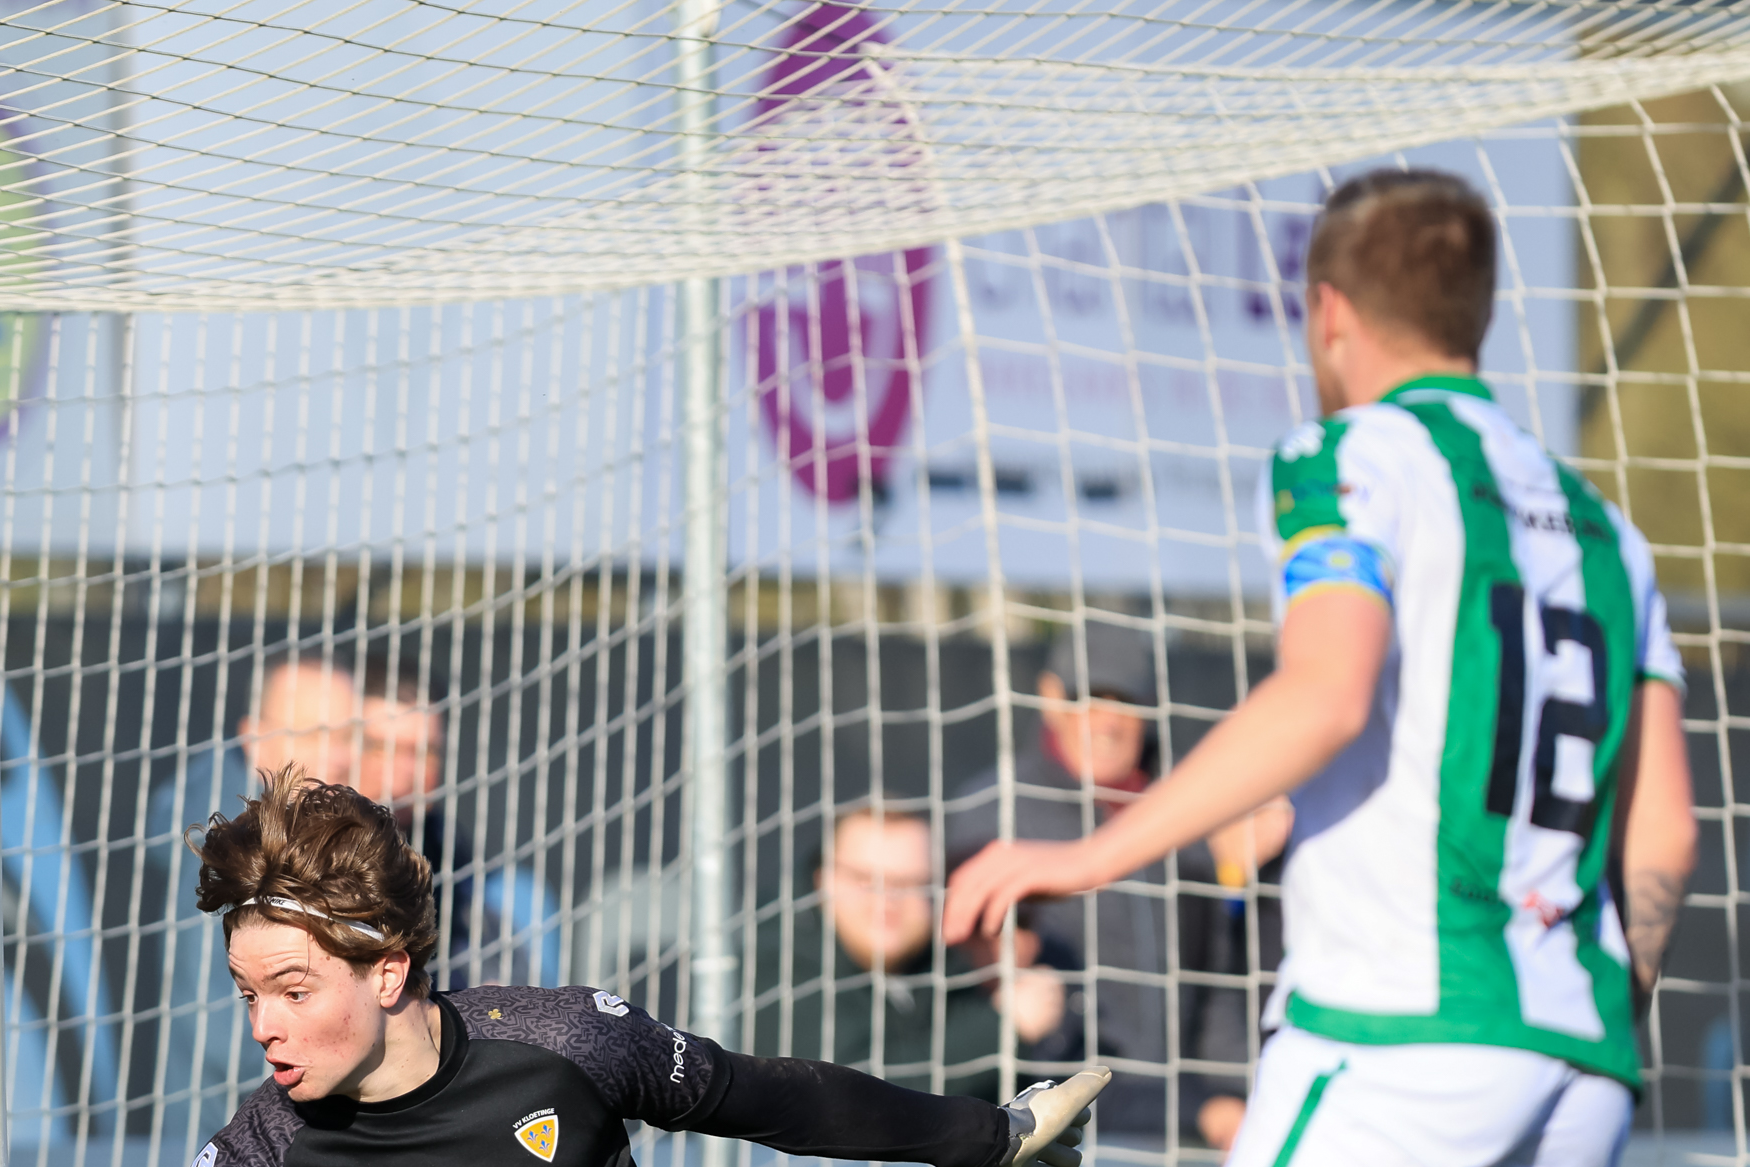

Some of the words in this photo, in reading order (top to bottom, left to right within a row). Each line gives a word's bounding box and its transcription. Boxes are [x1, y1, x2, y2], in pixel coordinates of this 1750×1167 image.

[1485, 581, 1611, 837] 12
[512, 1119, 523, 1129] VV
[521, 1107, 555, 1124] KLOETINGE
